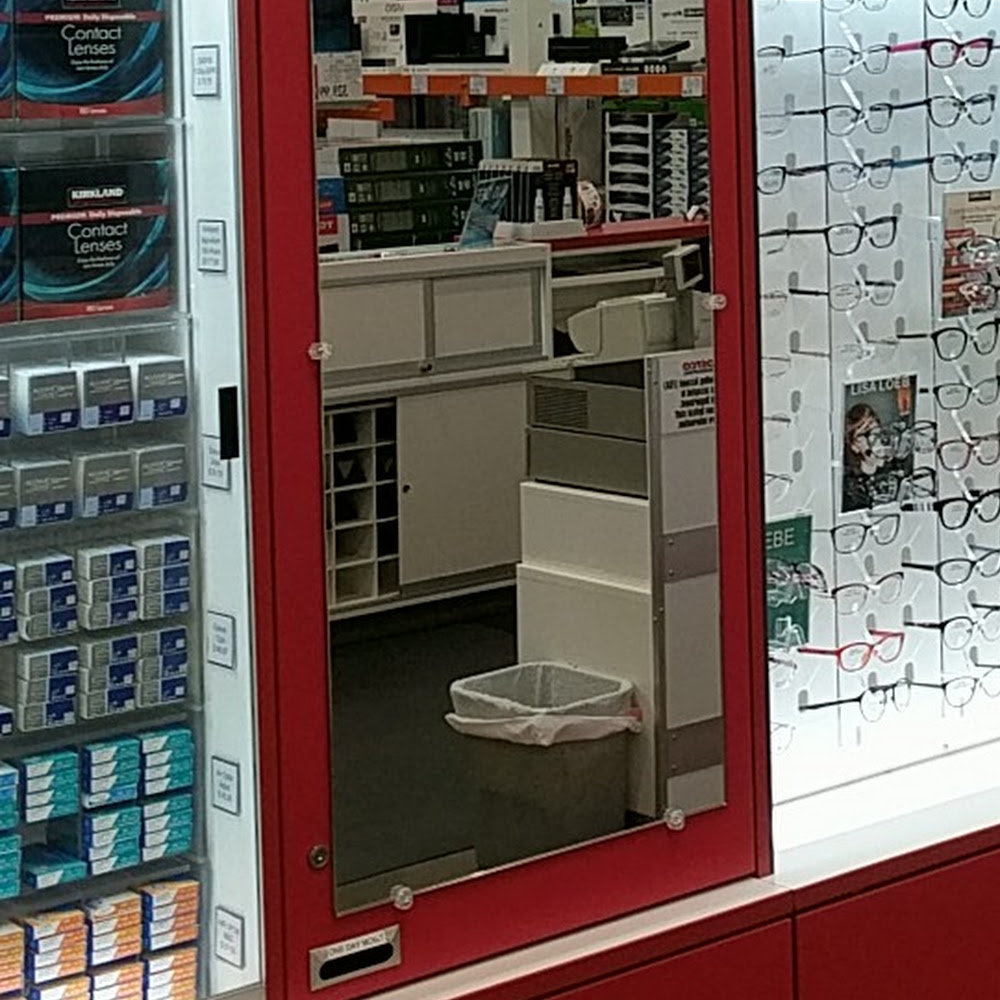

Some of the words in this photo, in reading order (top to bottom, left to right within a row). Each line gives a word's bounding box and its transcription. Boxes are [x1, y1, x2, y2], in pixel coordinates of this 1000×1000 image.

[61, 24, 121, 41] Contact
[68, 40, 117, 56] Lenses
[72, 188, 124, 200] KIRKLAND
[67, 222, 128, 240] Contact
[74, 239, 123, 255] Lenses
[851, 379, 877, 396] LISA
